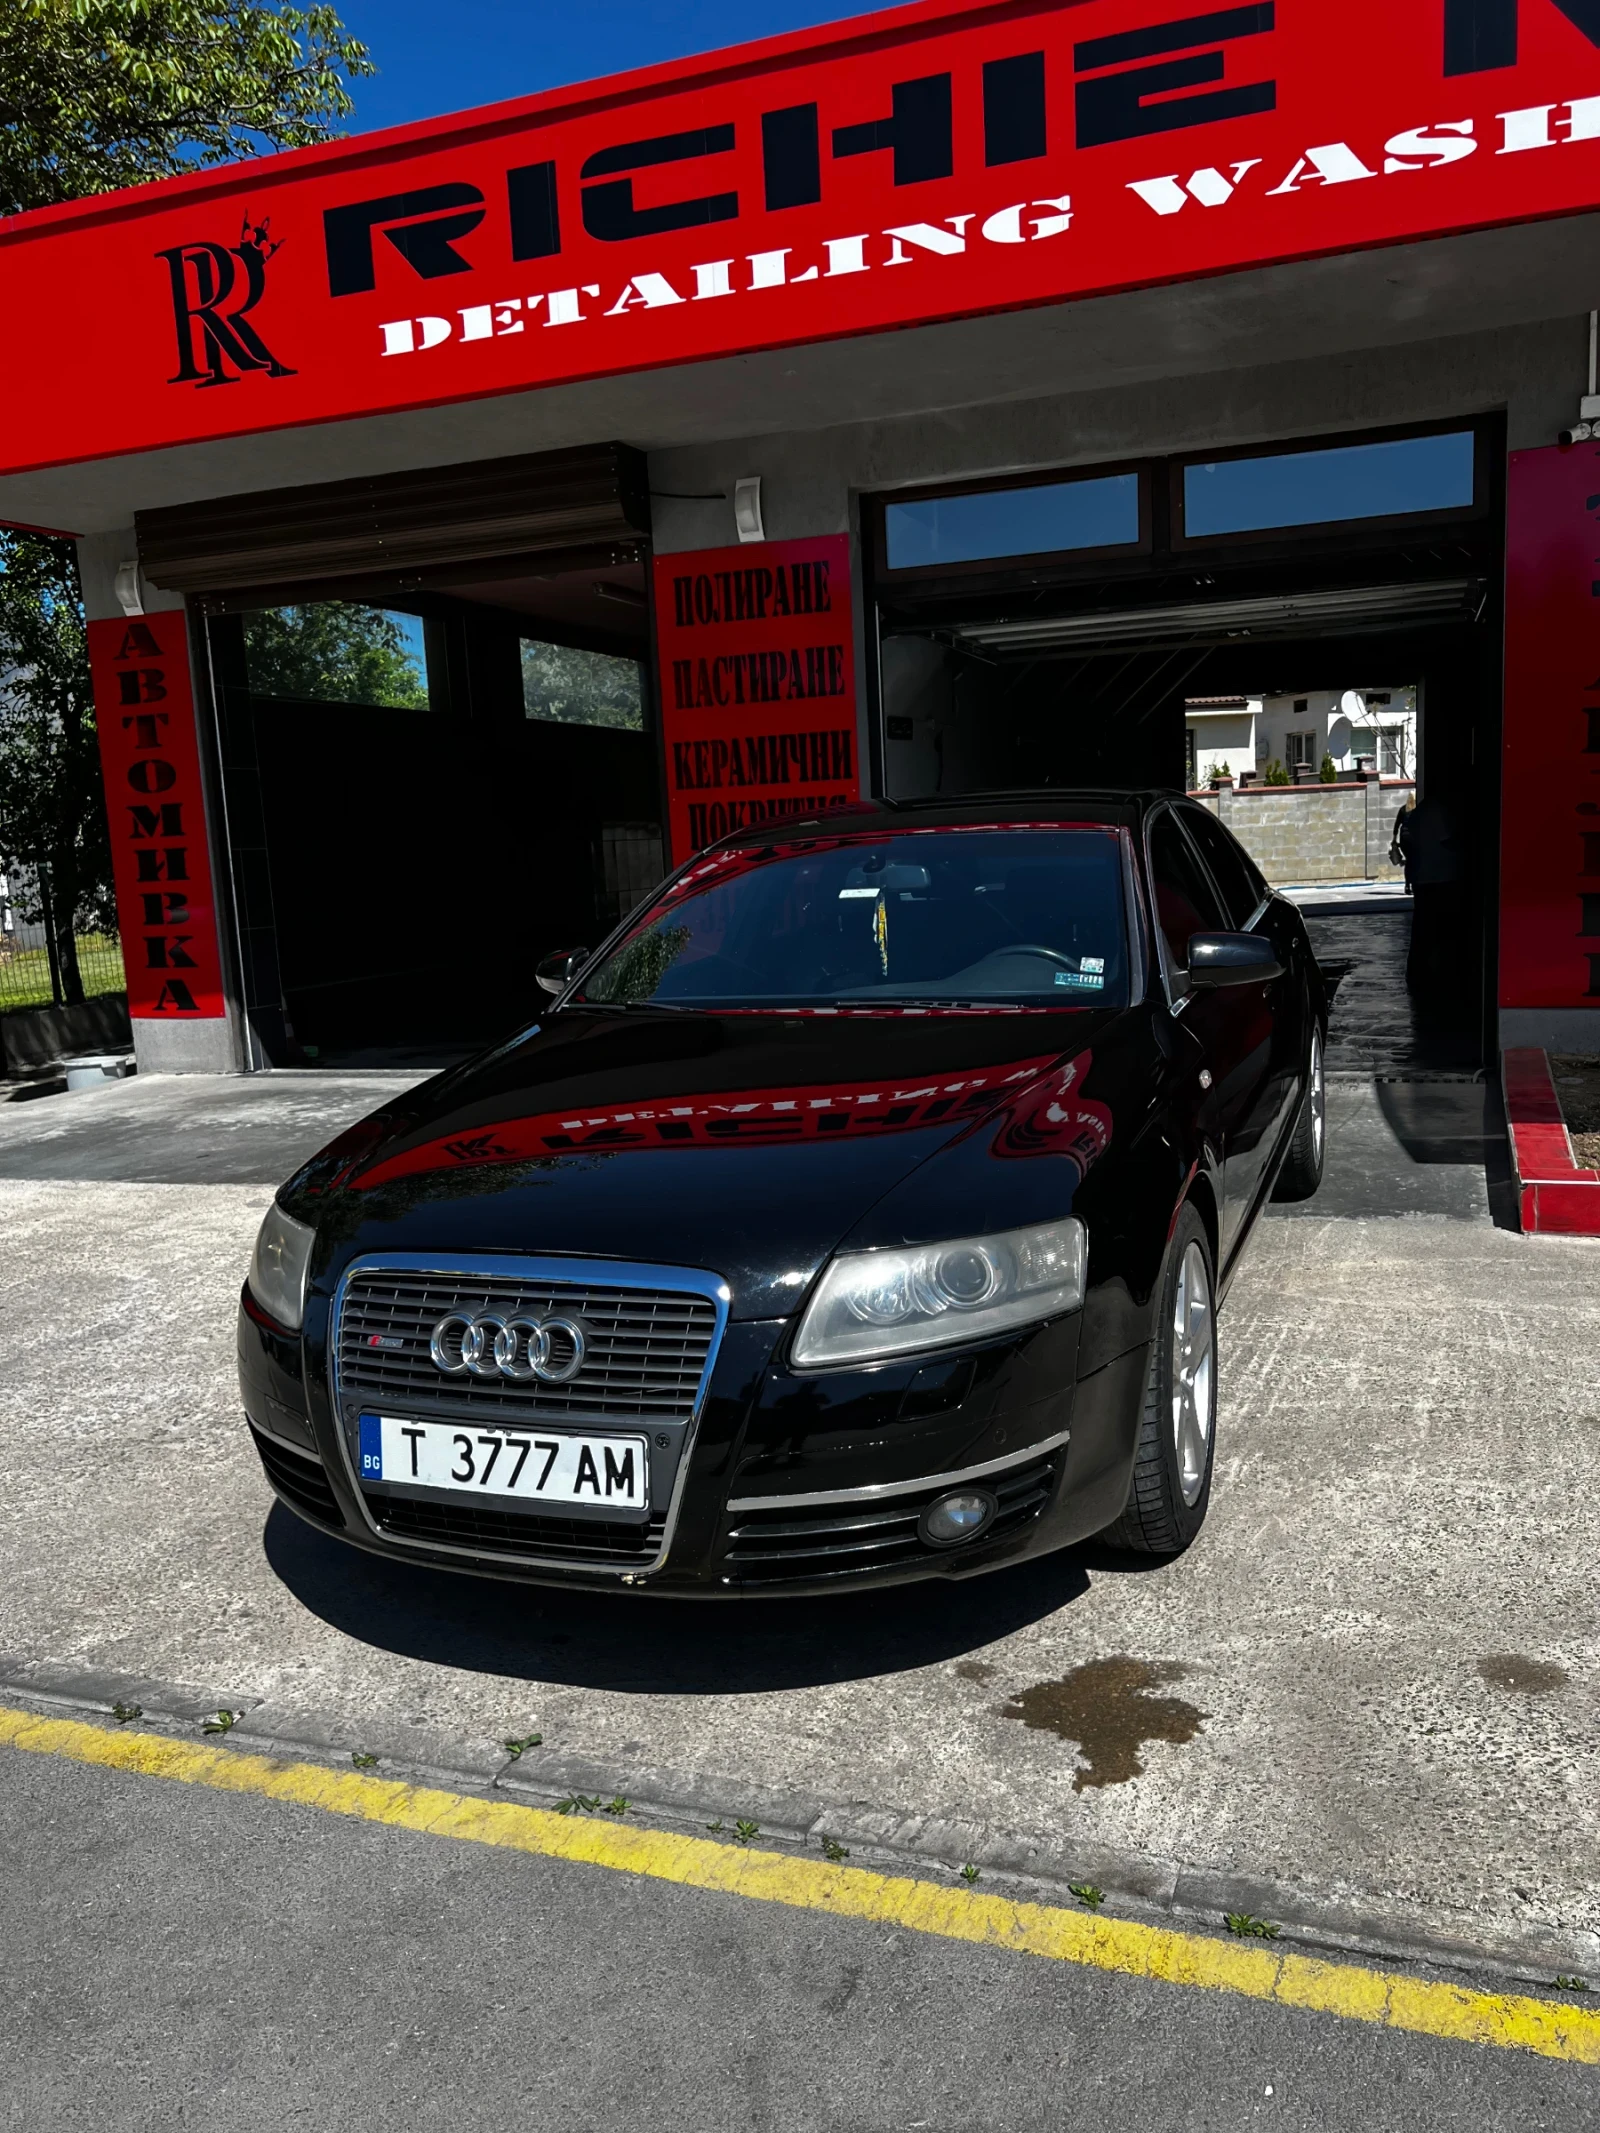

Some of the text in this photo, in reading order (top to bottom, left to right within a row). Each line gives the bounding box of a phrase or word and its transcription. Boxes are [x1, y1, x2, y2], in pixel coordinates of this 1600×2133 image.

[323, 1, 1276, 298] RICHE
[380, 195, 1075, 356] DETAILING
[672, 561, 831, 627] ПОЛИРАНЕ
[672, 645, 845, 709] ПАСТИРАНЕ
[672, 730, 853, 790] КЕРАМИЧНИ
[113, 622, 200, 1011] АВТОМИВКА
[363, 1454, 380, 1471] BG
[402, 1428, 634, 1498] T 3777 AM
